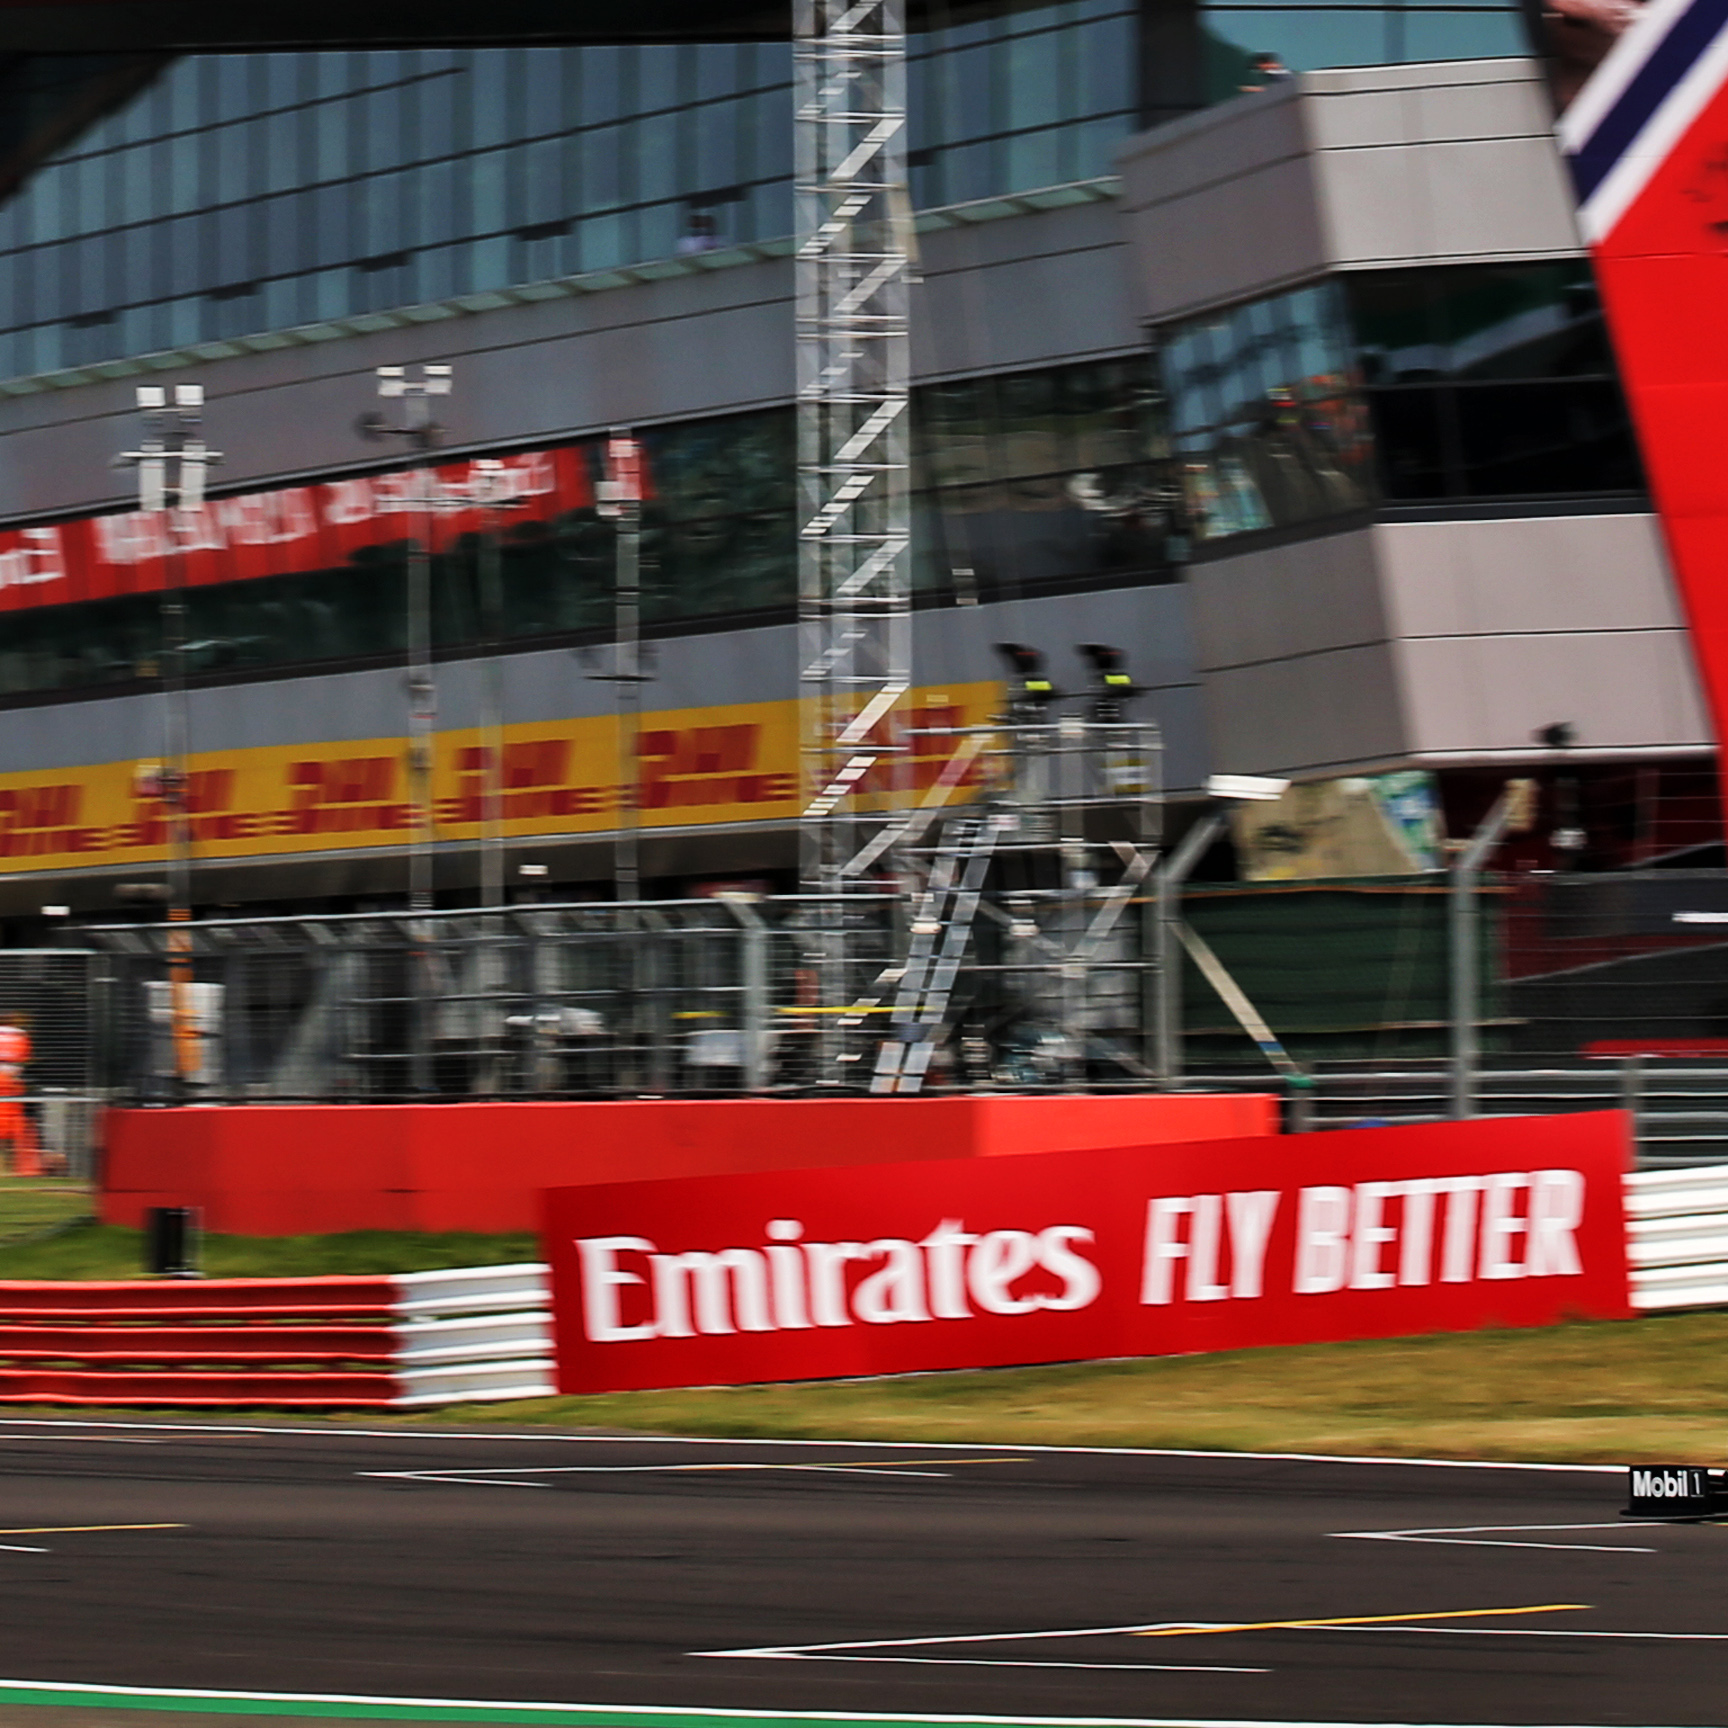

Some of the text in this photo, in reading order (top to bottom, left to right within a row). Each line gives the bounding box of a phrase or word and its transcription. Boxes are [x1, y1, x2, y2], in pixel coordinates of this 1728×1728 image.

[573, 1169, 1586, 1342] Emirates FLY BETTER
[1633, 1470, 1701, 1498] Mobil 1
